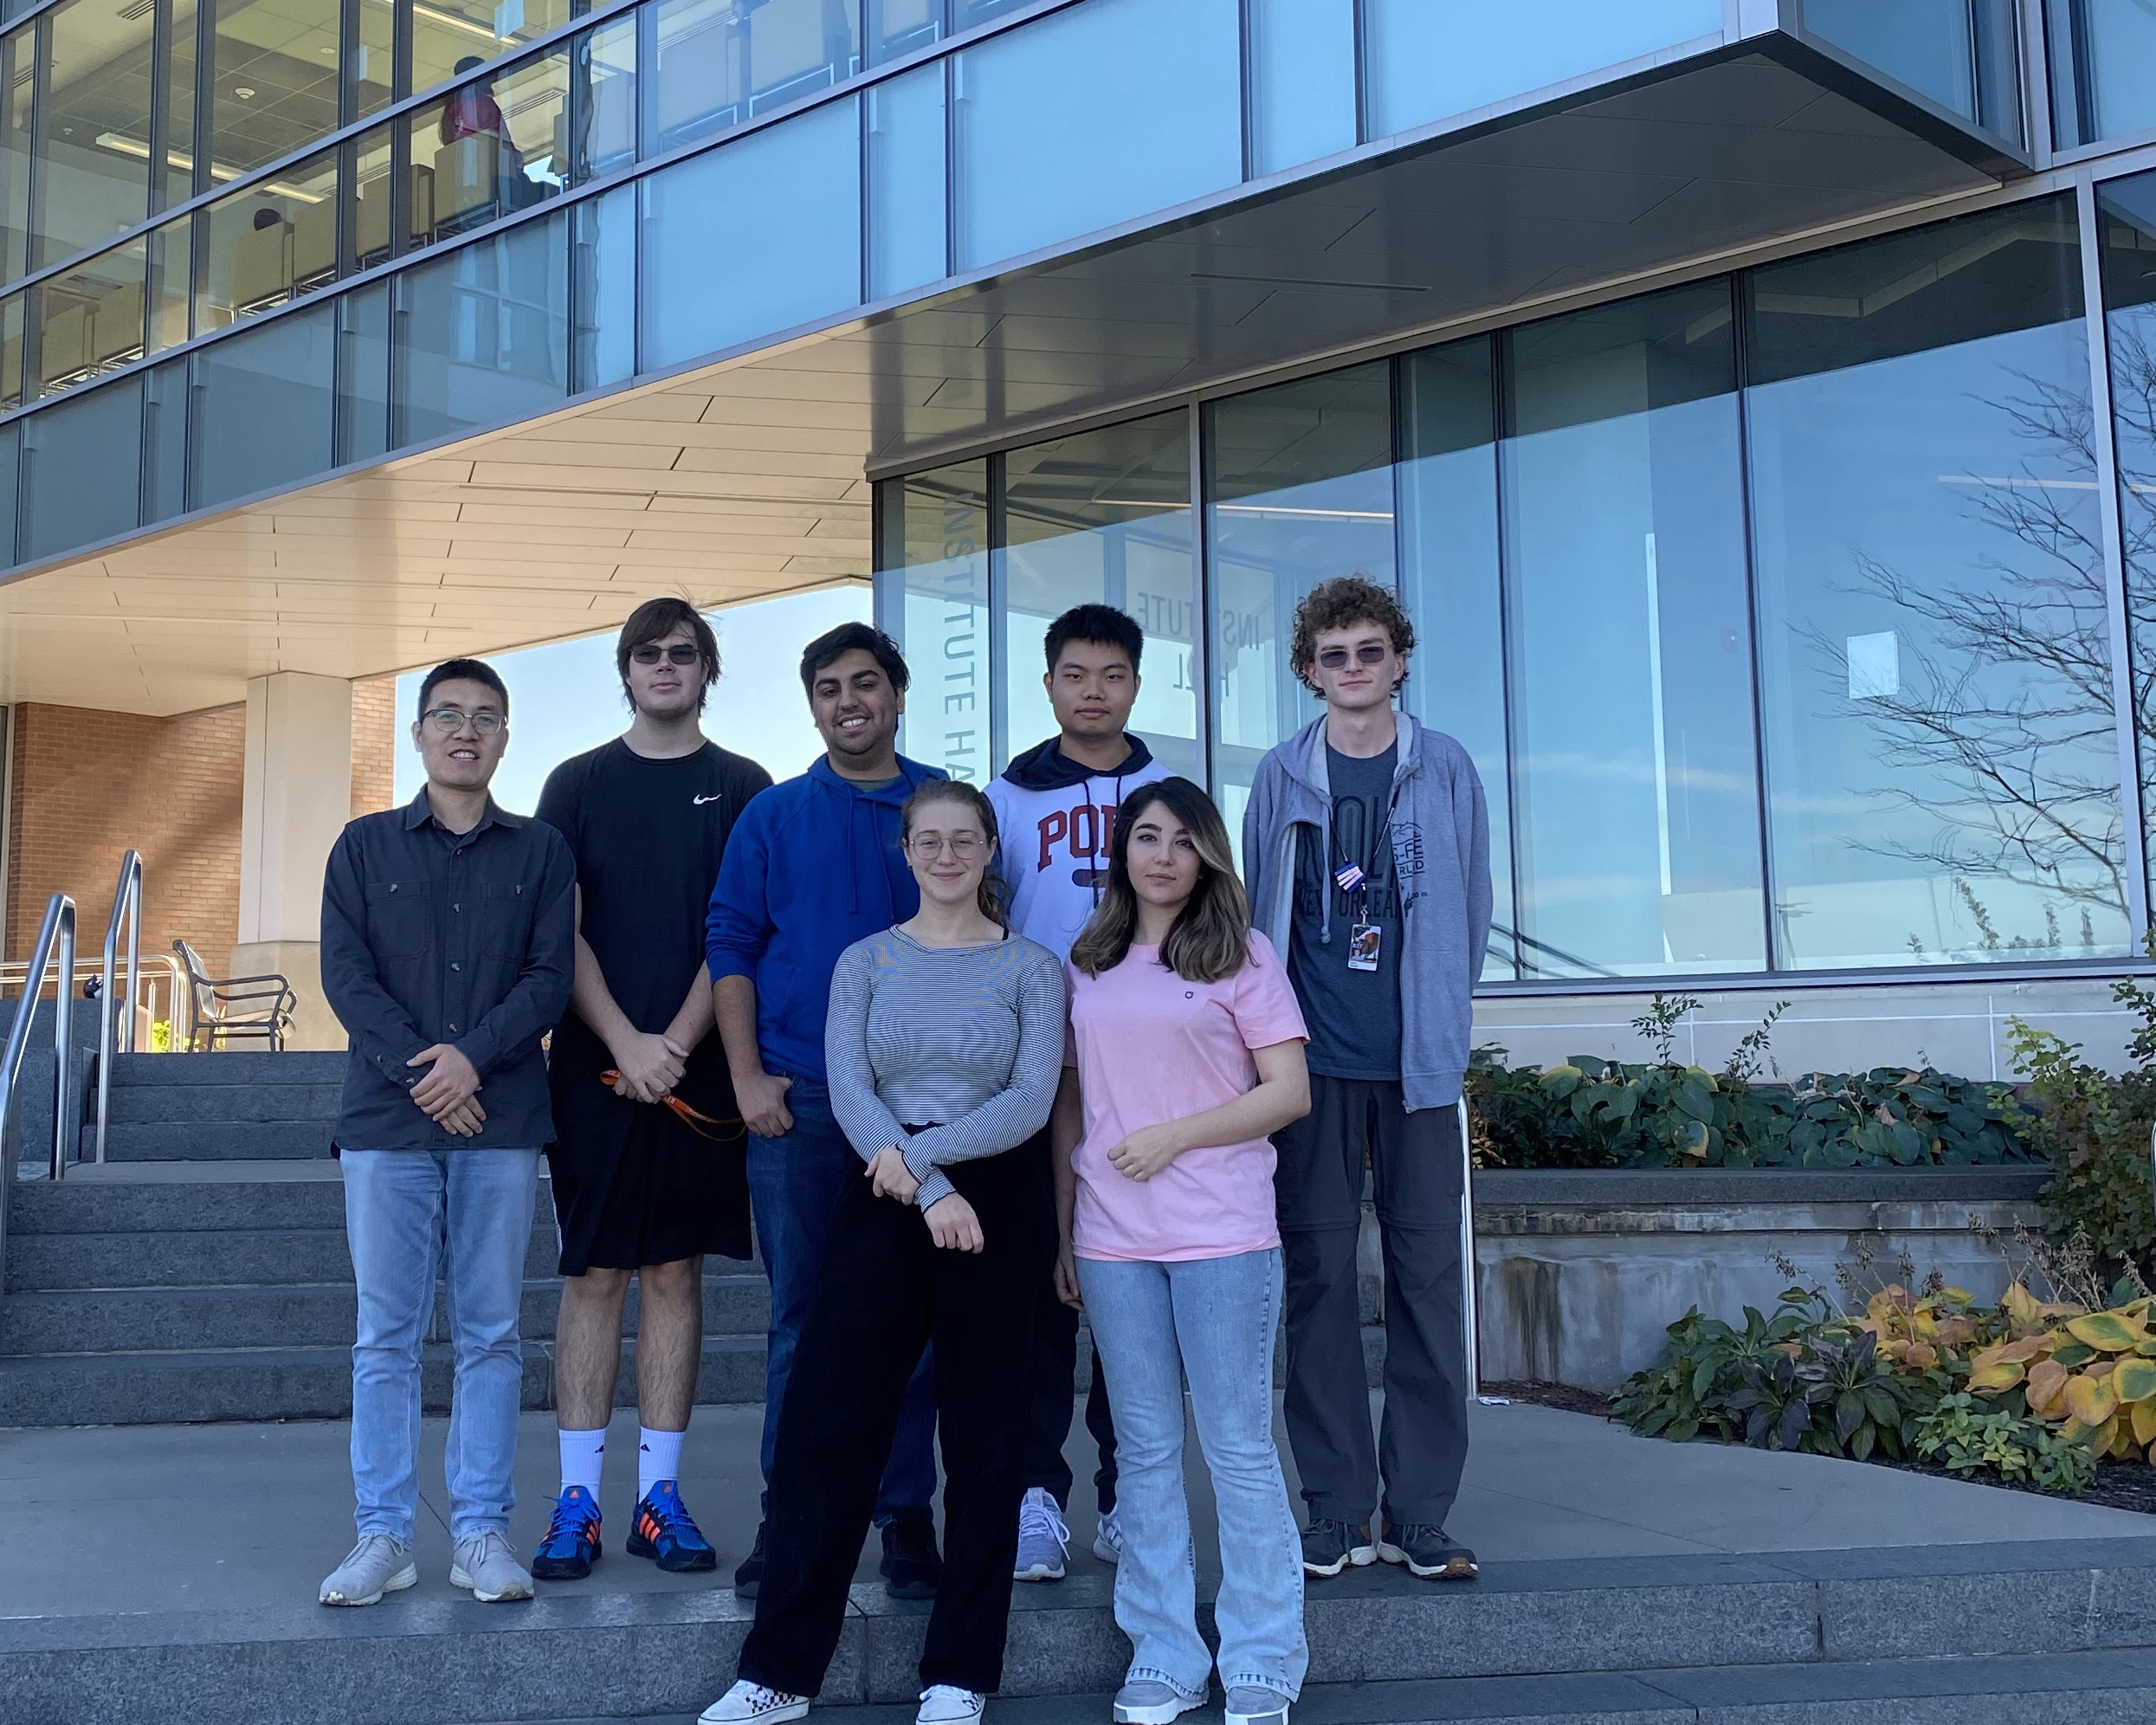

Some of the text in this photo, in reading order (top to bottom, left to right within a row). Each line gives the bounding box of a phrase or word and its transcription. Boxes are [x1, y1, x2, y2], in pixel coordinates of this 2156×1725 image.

[945, 492, 976, 780] INSTITUTE HA
[1037, 804, 1117, 873] PO
